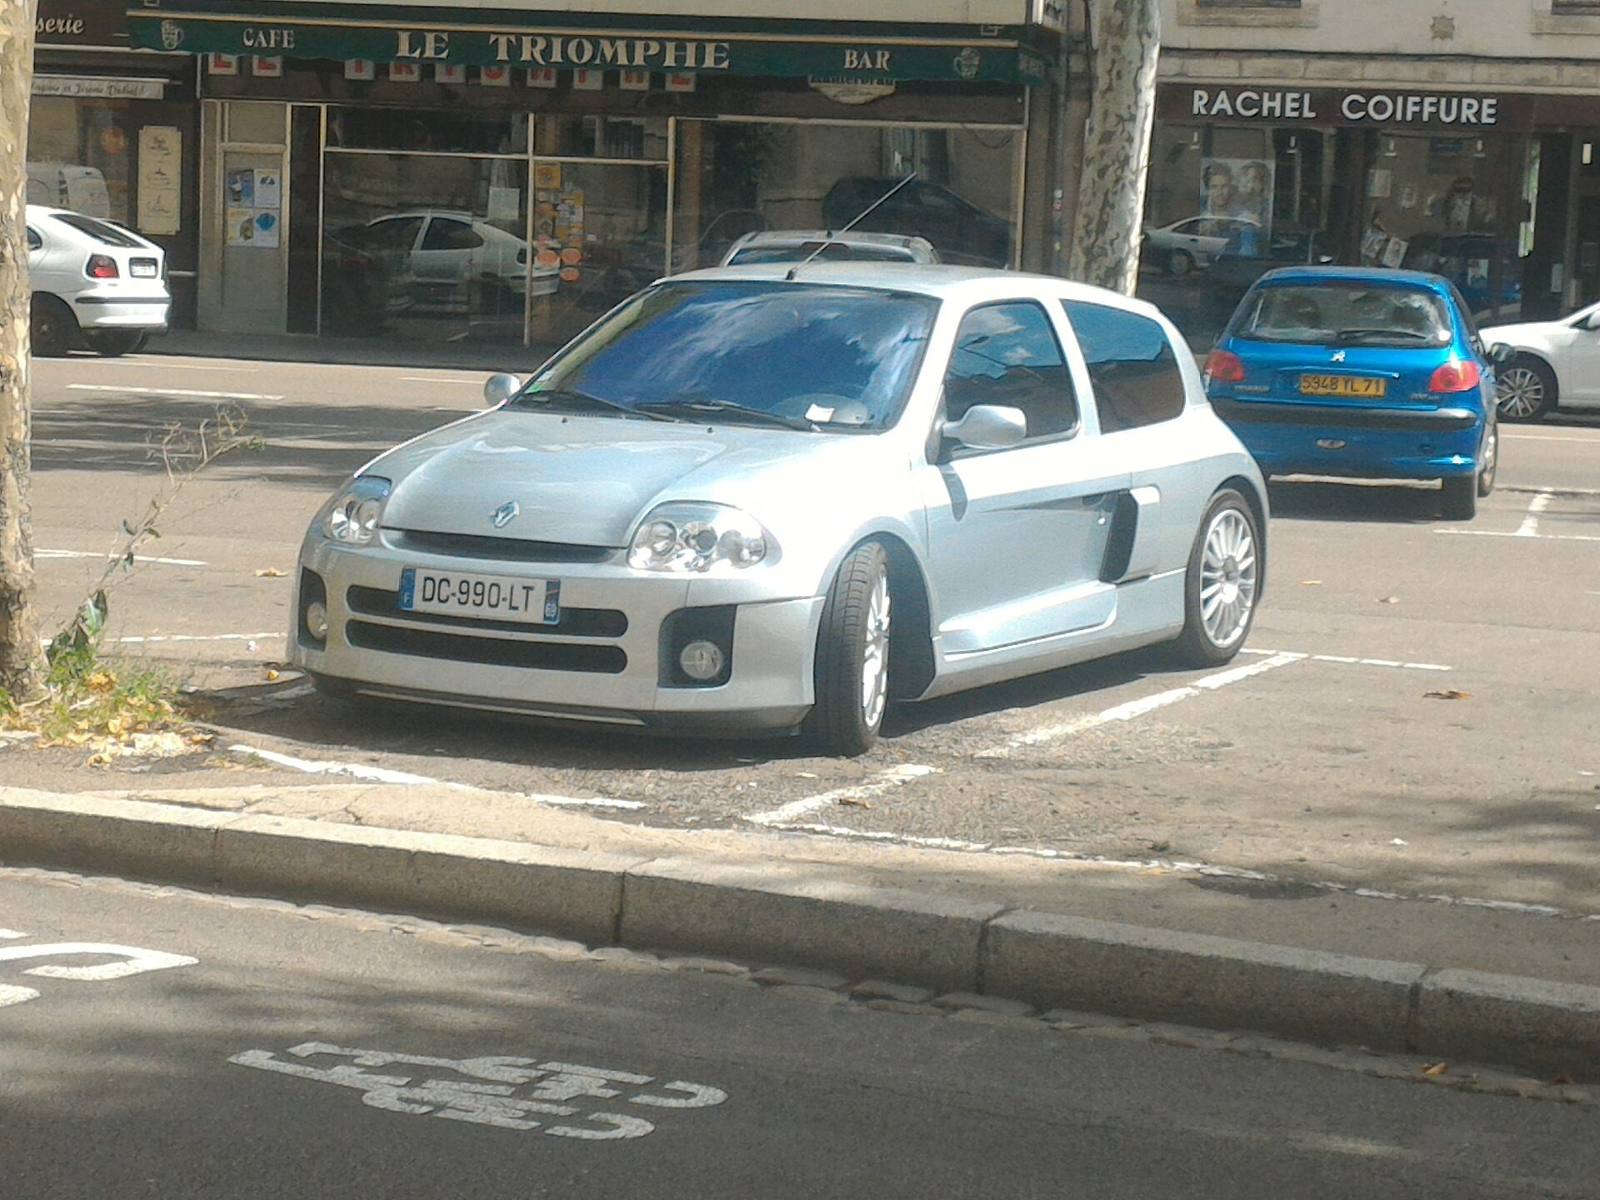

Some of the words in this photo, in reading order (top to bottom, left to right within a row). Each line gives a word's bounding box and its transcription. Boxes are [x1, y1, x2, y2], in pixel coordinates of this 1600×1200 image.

[242, 28, 295, 49] CAFE
[395, 31, 450, 59] LE
[488, 34, 731, 70] TRIOMPHE
[843, 49, 891, 71] BAR
[1192, 89, 1318, 119] RACHEL
[1341, 94, 1499, 125] COIFFURE
[1363, 380, 1383, 394] 71
